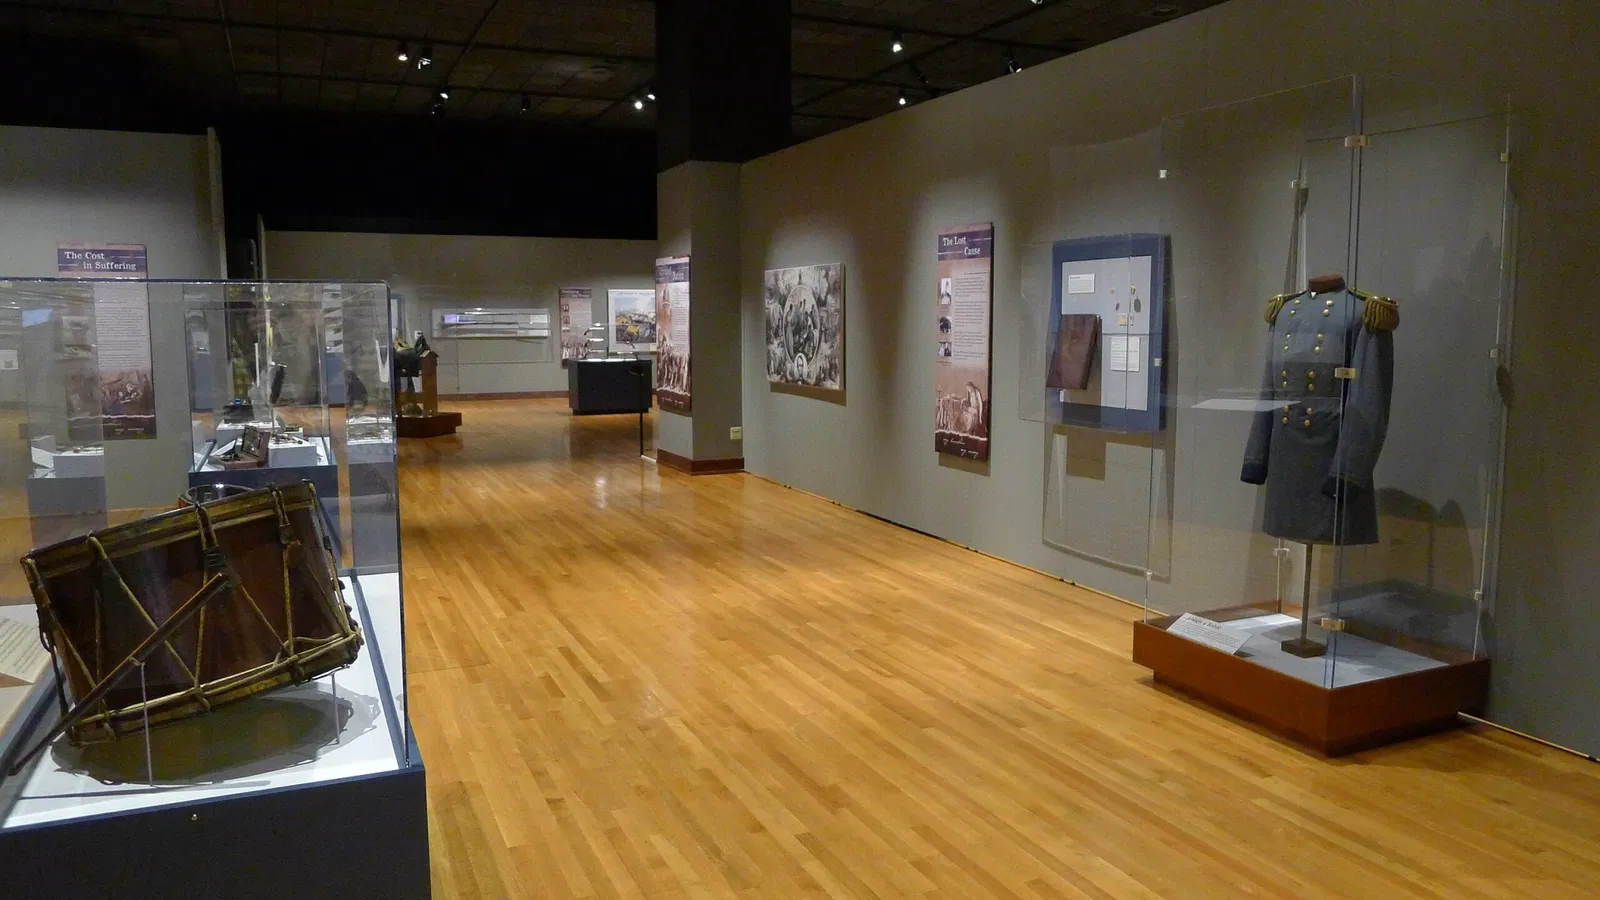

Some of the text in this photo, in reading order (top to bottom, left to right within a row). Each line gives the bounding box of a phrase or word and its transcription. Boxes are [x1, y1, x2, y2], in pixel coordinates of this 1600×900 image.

[942, 236, 966, 246] The Lost
[64, 251, 105, 260] The Cost
[964, 247, 980, 255] Cause
[83, 261, 137, 271] in Suffering
